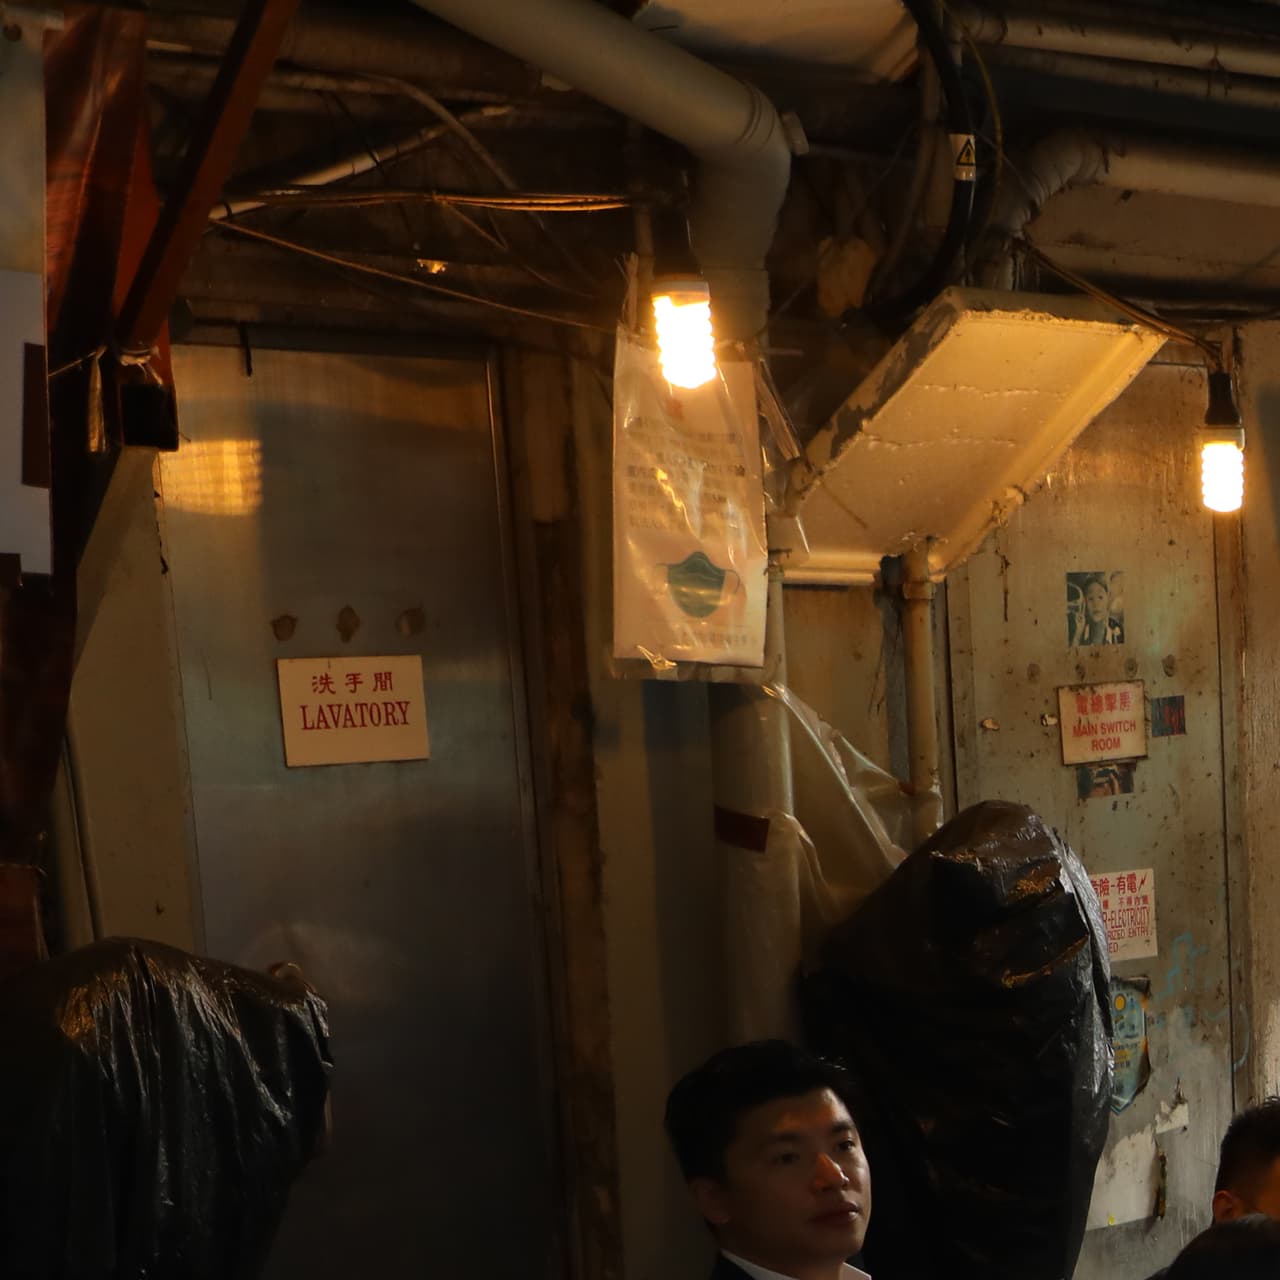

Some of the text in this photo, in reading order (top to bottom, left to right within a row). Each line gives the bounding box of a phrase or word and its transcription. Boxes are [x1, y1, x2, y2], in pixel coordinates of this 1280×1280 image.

[312, 672, 393, 695] 洗手間
[300, 701, 411, 731] LAVATORY
[1073, 720, 1136, 738] MAIN SWITCH
[1091, 738, 1120, 751] ROOM
[1102, 907, 1150, 929] R-ELECTRICITY
[1107, 928, 1126, 940] RIZED
